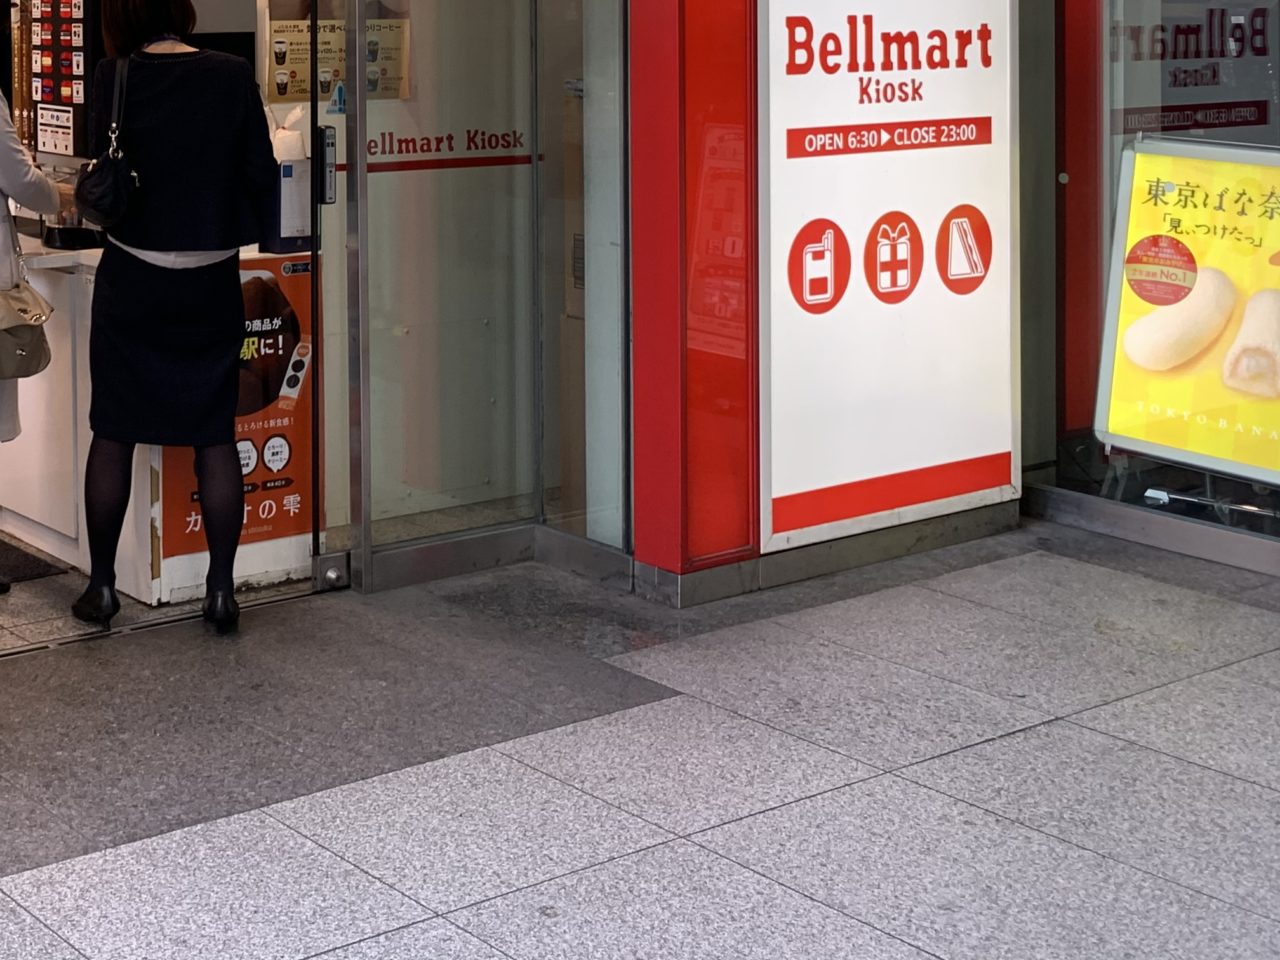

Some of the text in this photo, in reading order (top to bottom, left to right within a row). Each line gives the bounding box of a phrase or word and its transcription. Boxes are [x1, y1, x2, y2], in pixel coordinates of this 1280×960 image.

[785, 15, 992, 76] Bellmart
[858, 77, 924, 104] Kiosk
[466, 128, 524, 152] Kiosk
[804, 123, 976, 152] OPEN 6:30 CLOSE 23:00
[1141, 177, 1280, 221] 東京ばな奈
[1160, 270, 1188, 283] No.1
[1136, 400, 1208, 425] TOKYO
[185, 493, 301, 534] カの雫
